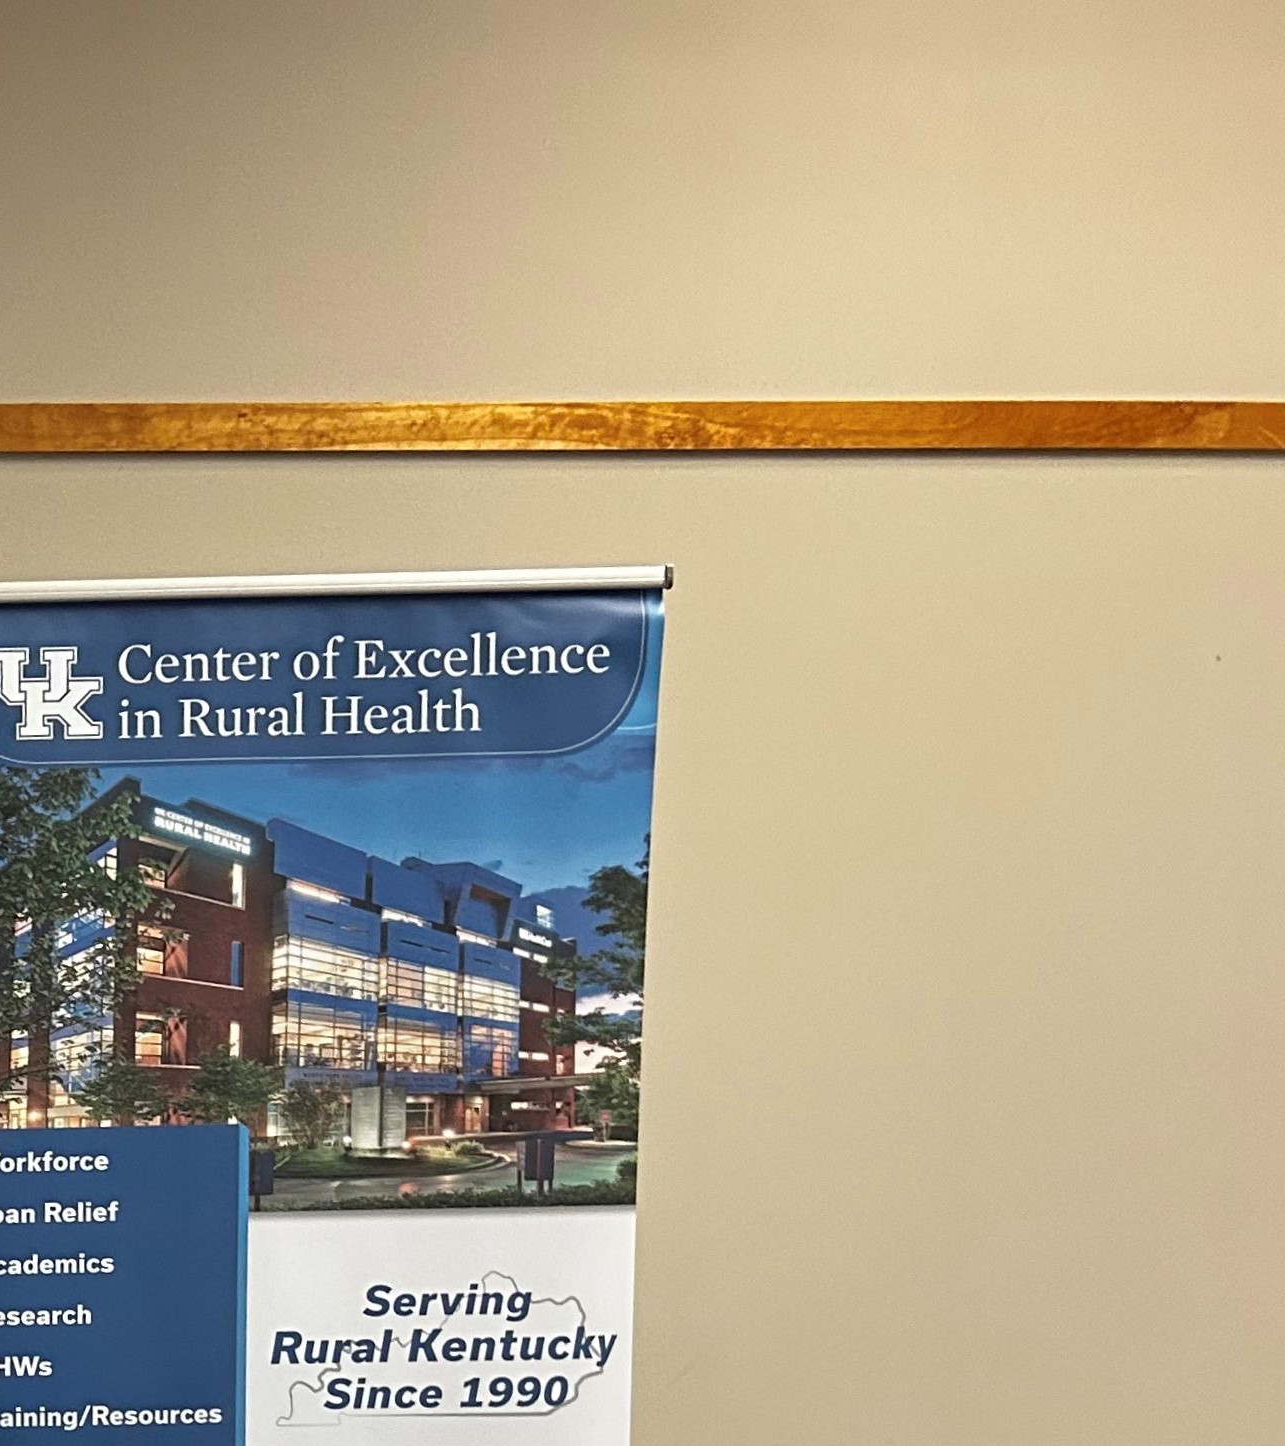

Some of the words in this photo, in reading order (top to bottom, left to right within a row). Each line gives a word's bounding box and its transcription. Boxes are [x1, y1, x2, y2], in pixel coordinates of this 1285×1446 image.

[119, 645, 279, 683] Center
[294, 635, 344, 680] of
[354, 632, 609, 678] Excellence
[119, 699, 162, 738] in
[179, 692, 305, 737] Rural
[321, 688, 481, 734] Health
[154, 816, 202, 839] RURAL
[203, 832, 251, 855] HEALTH
[45, 1201, 118, 1222] Relief
[363, 1284, 532, 1322] Serving
[271, 1329, 391, 1364] Rural
[407, 1326, 617, 1366] Kentucky
[324, 1376, 443, 1411] Since
[460, 1376, 570, 1408] 1990
